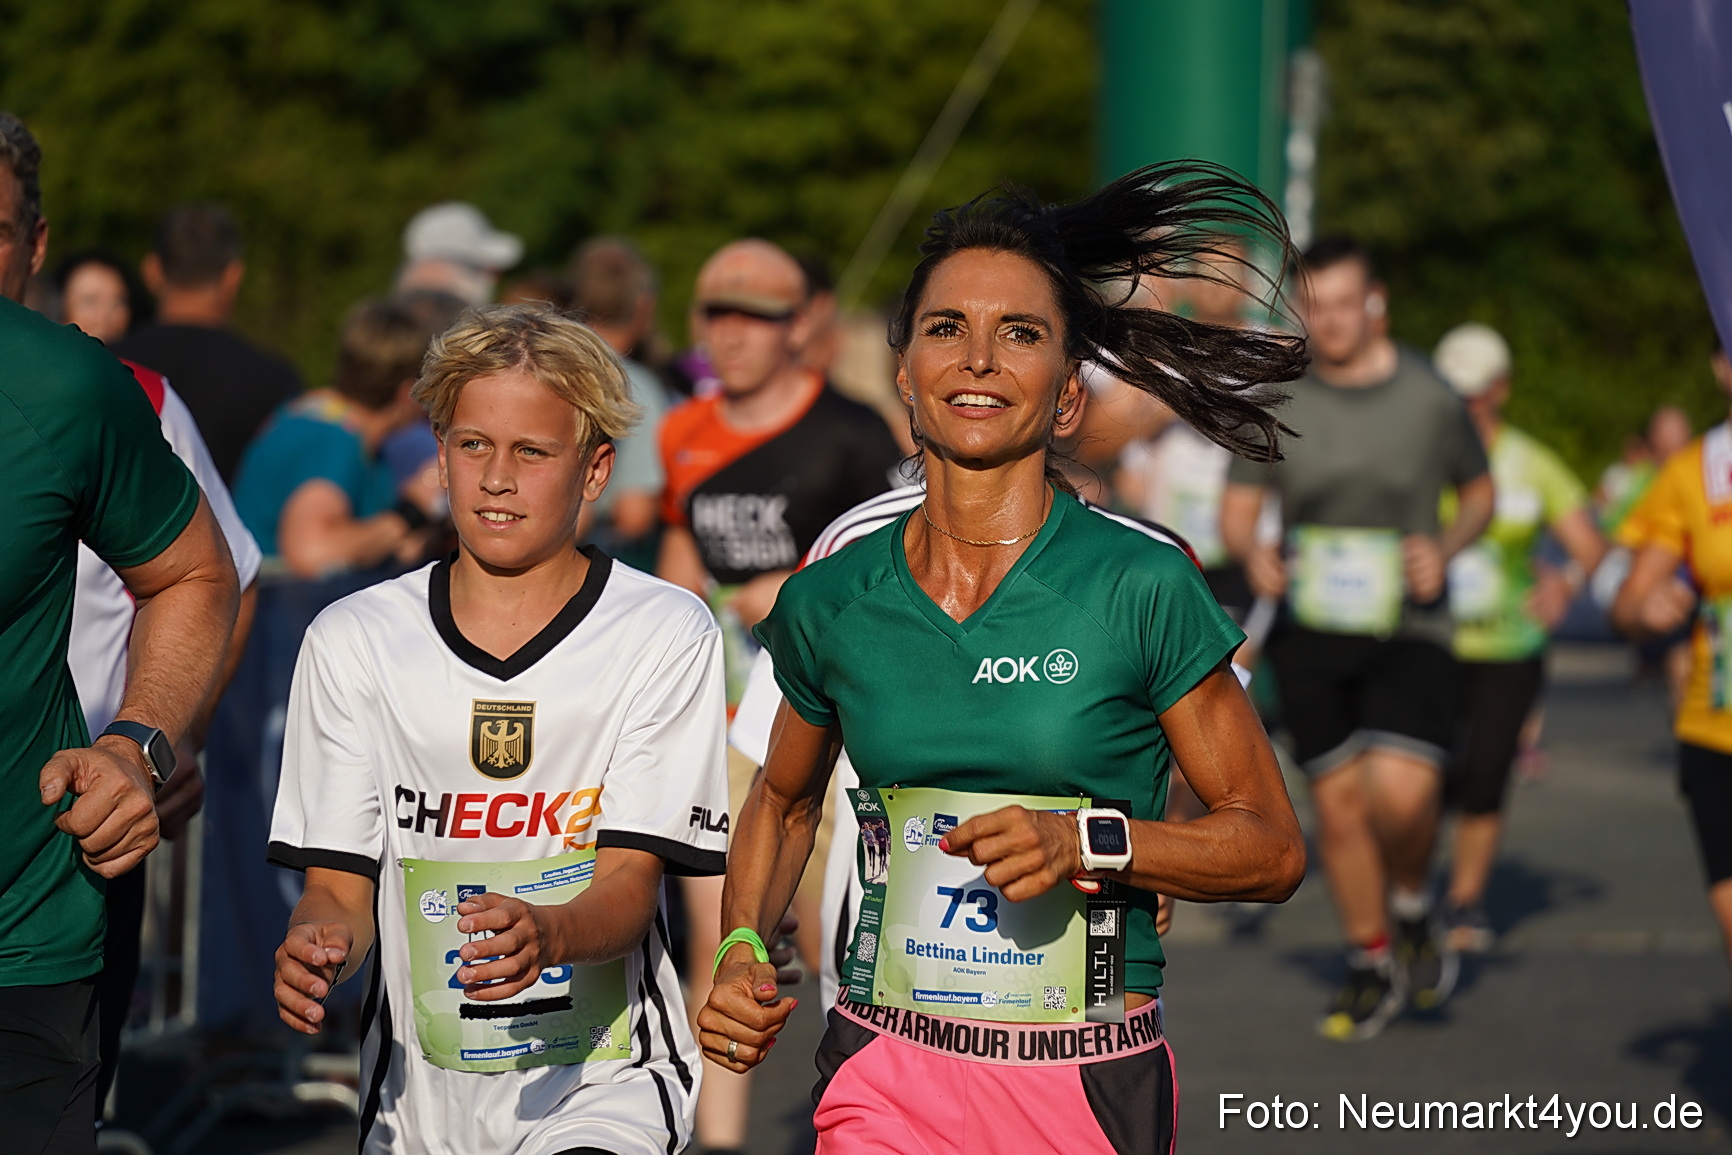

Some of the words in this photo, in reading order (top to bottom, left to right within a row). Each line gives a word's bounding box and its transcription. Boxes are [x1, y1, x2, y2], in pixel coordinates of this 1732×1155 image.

[971, 656, 1040, 684] AOK
[476, 703, 532, 711] DEUTSCHLAND
[394, 783, 604, 839] CHECK2
[689, 805, 729, 834] FILA
[857, 802, 881, 812] AOK
[937, 886, 998, 933] 73
[905, 938, 967, 962] Bettina
[972, 946, 1044, 966] Lindner
[966, 968, 987, 976] Bayern
[1094, 942, 1107, 1007] HILTL
[915, 992, 978, 1004] firmenlauf.bayern
[520, 1020, 539, 1028] GmbH
[900, 1010, 1010, 1060] ARMOUR
[1018, 1023, 1114, 1060] UNDER
[1116, 1005, 1163, 1052] ARM
[463, 1046, 528, 1059] firmenlauf.bayern
